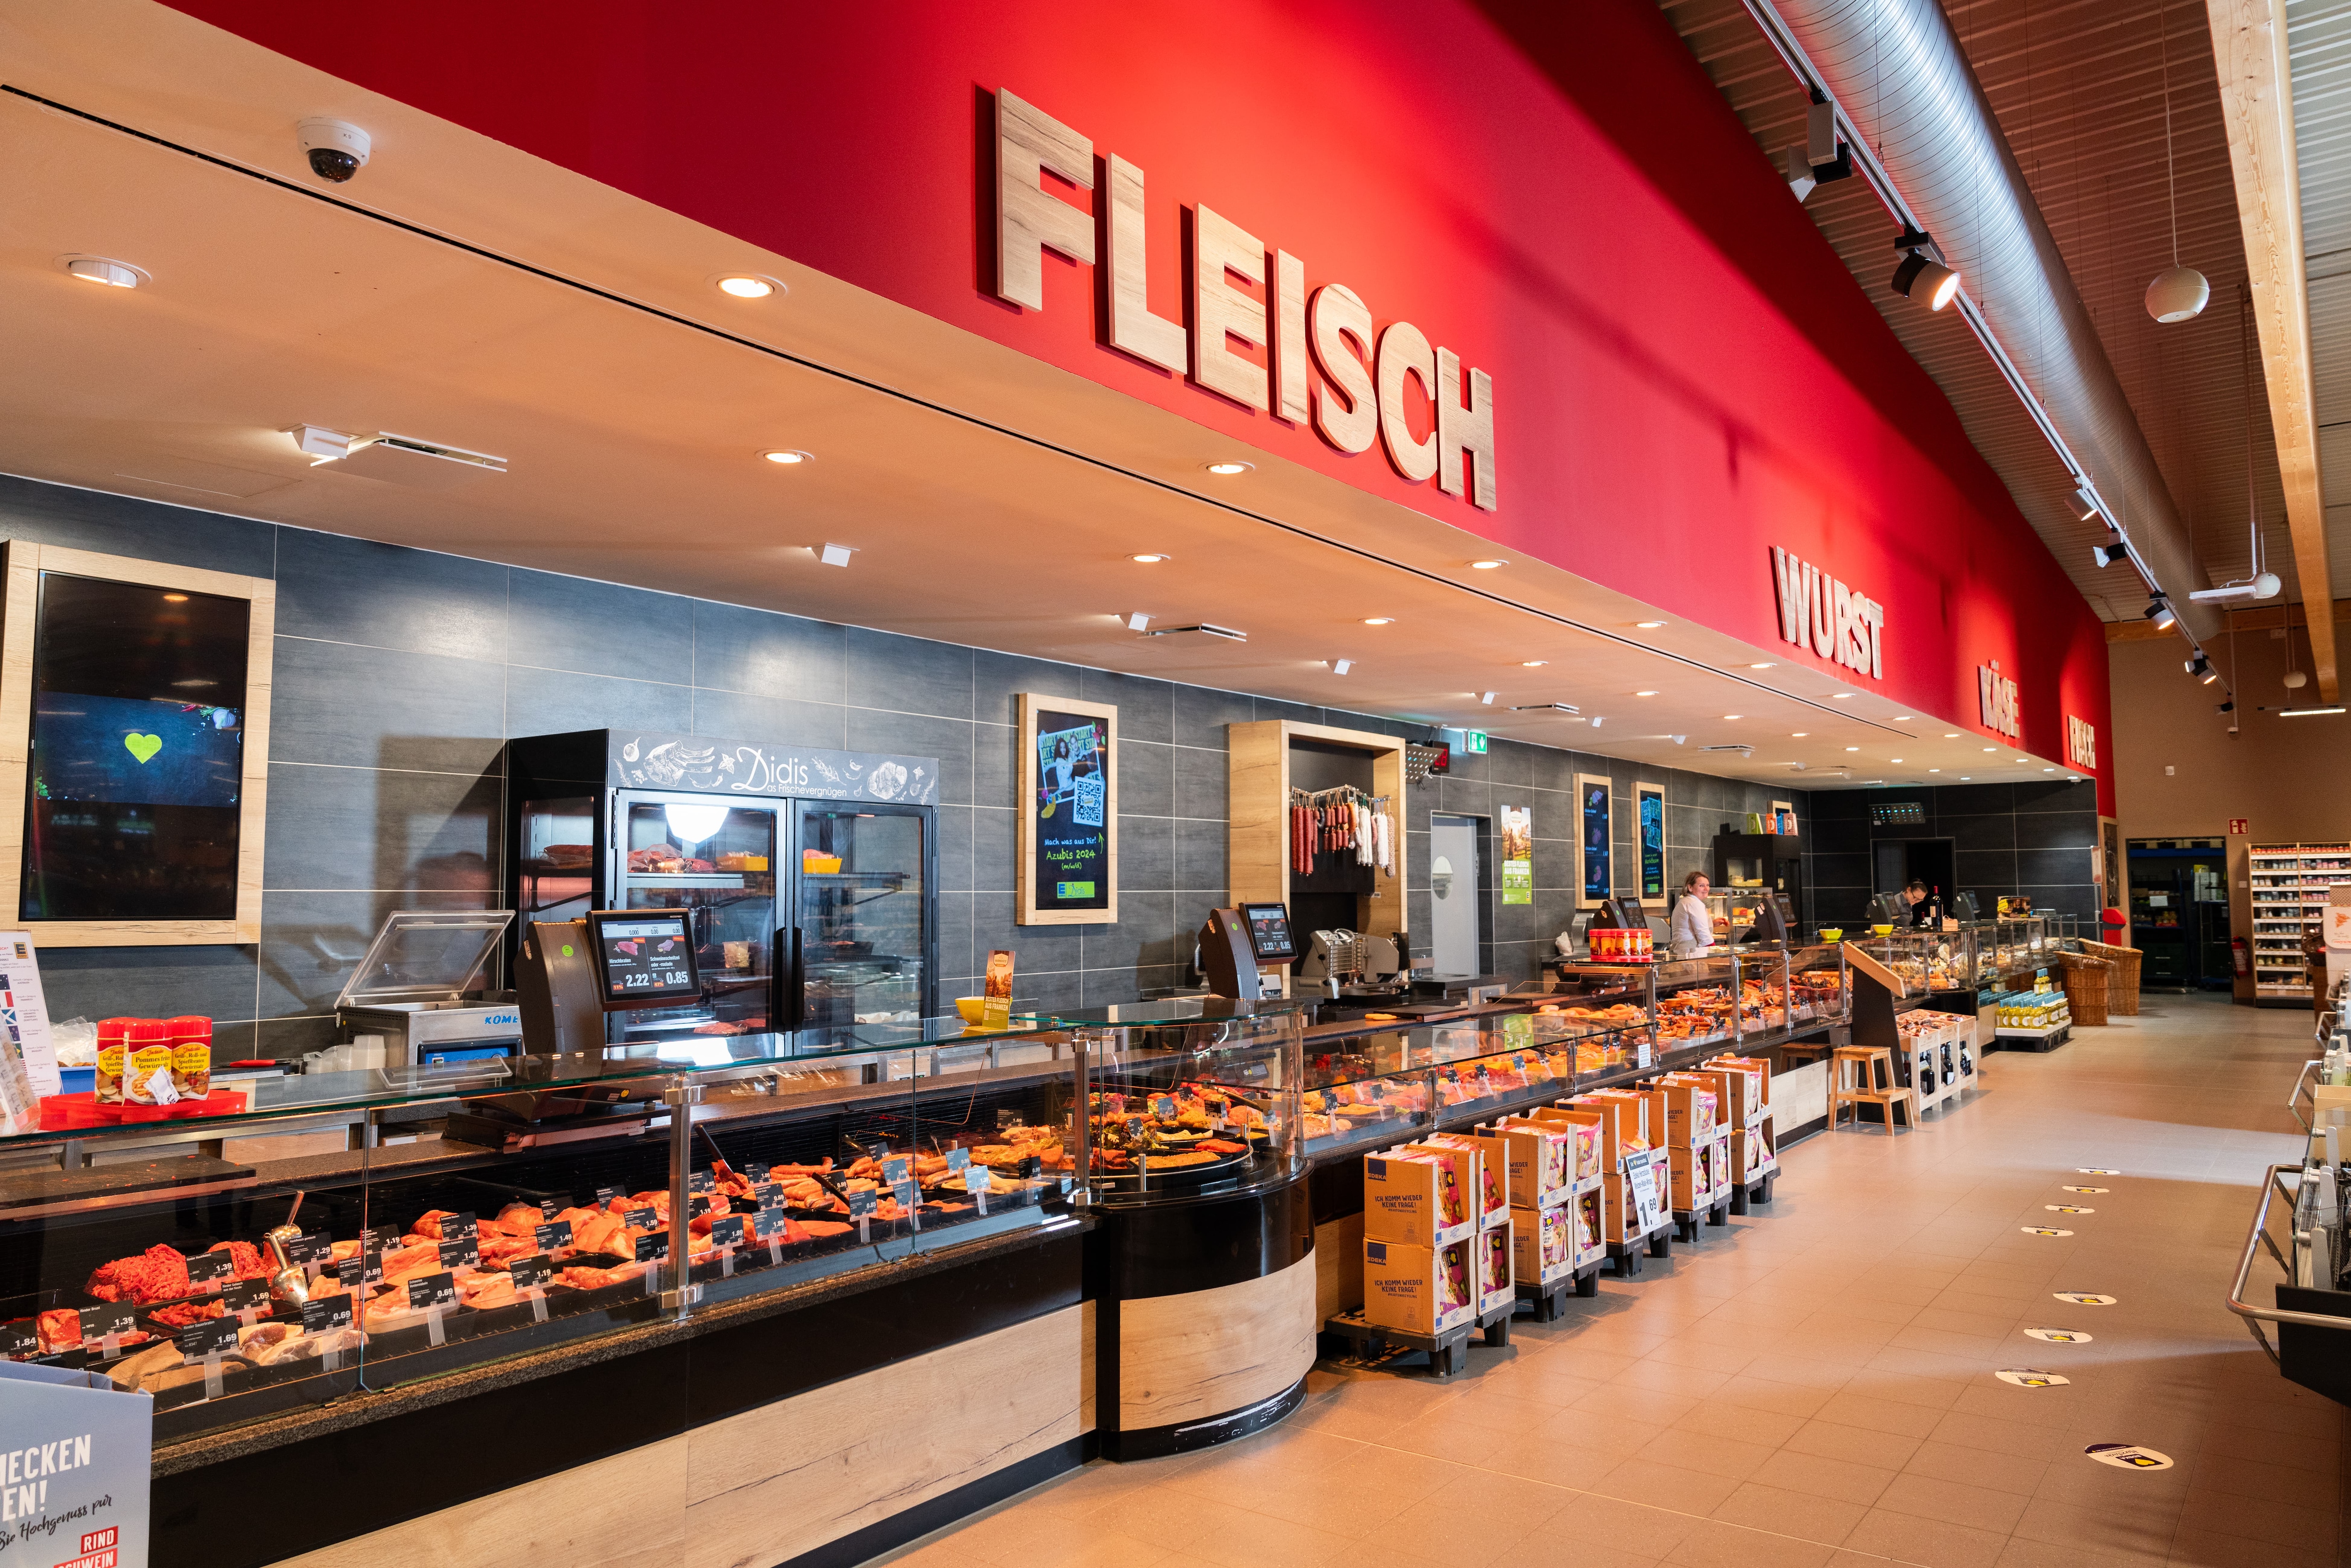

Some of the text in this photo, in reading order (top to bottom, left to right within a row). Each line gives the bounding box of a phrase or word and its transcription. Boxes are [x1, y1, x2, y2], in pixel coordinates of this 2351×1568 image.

[996, 87, 1497, 512] FLEISCH
[1774, 545, 1884, 679] WURST
[1980, 659, 2020, 738] KÄSE
[2069, 715, 2096, 769] FISCH
[731, 747, 808, 791] Didis
[779, 784, 847, 798] Frischevergnügen
[1046, 848, 1096, 860] Azubis 2024
[1062, 862, 1082, 870] (m/w/d)
[626, 973, 649, 987] 2.22
[666, 971, 688, 985] 0.85
[484, 1015, 521, 1024] KOME
[1634, 1178, 1653, 1190] Weizen-Mais-Wraps
[316, 1246, 331, 1255] 1.29
[216, 1263, 232, 1271] 1.39
[366, 1268, 381, 1276] 0.69
[537, 1269, 552, 1277] 1.19
[253, 1292, 269, 1300] 1.69
[437, 1288, 453, 1297] 0.69
[114, 1316, 134, 1326] 1.39
[333, 1310, 351, 1321] 0.69
[15, 1337, 36, 1347] 1.84
[218, 1333, 237, 1343] 1.69
[0, 1480, 48, 1521] EN!
[20, 1505, 88, 1542] Hochgenuss
[92, 1494, 112, 1515] pur
[84, 1529, 114, 1552] RIND
